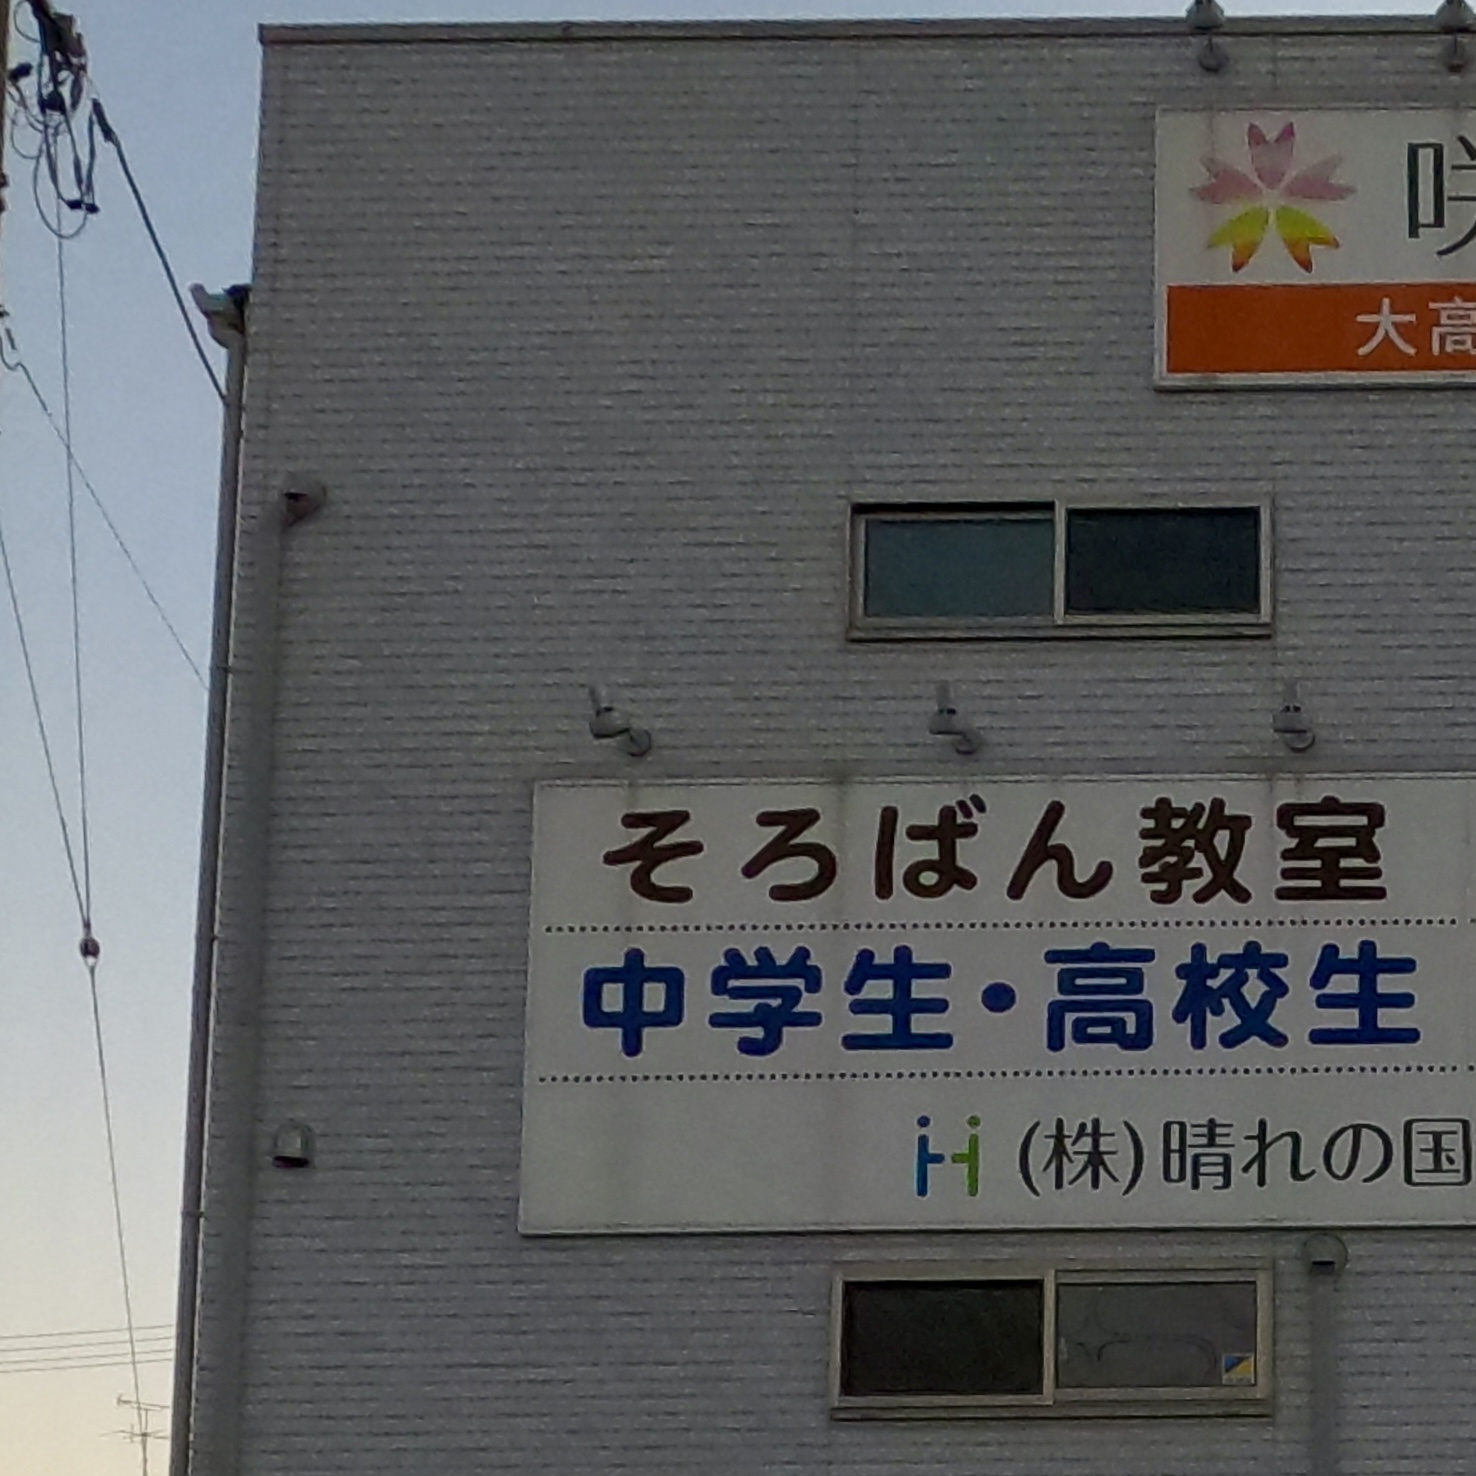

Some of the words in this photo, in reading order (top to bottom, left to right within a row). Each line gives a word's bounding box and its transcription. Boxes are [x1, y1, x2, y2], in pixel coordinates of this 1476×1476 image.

[602, 794, 1389, 905] そろばん教室
[582, 940, 1421, 1058] 中学生・高校生
